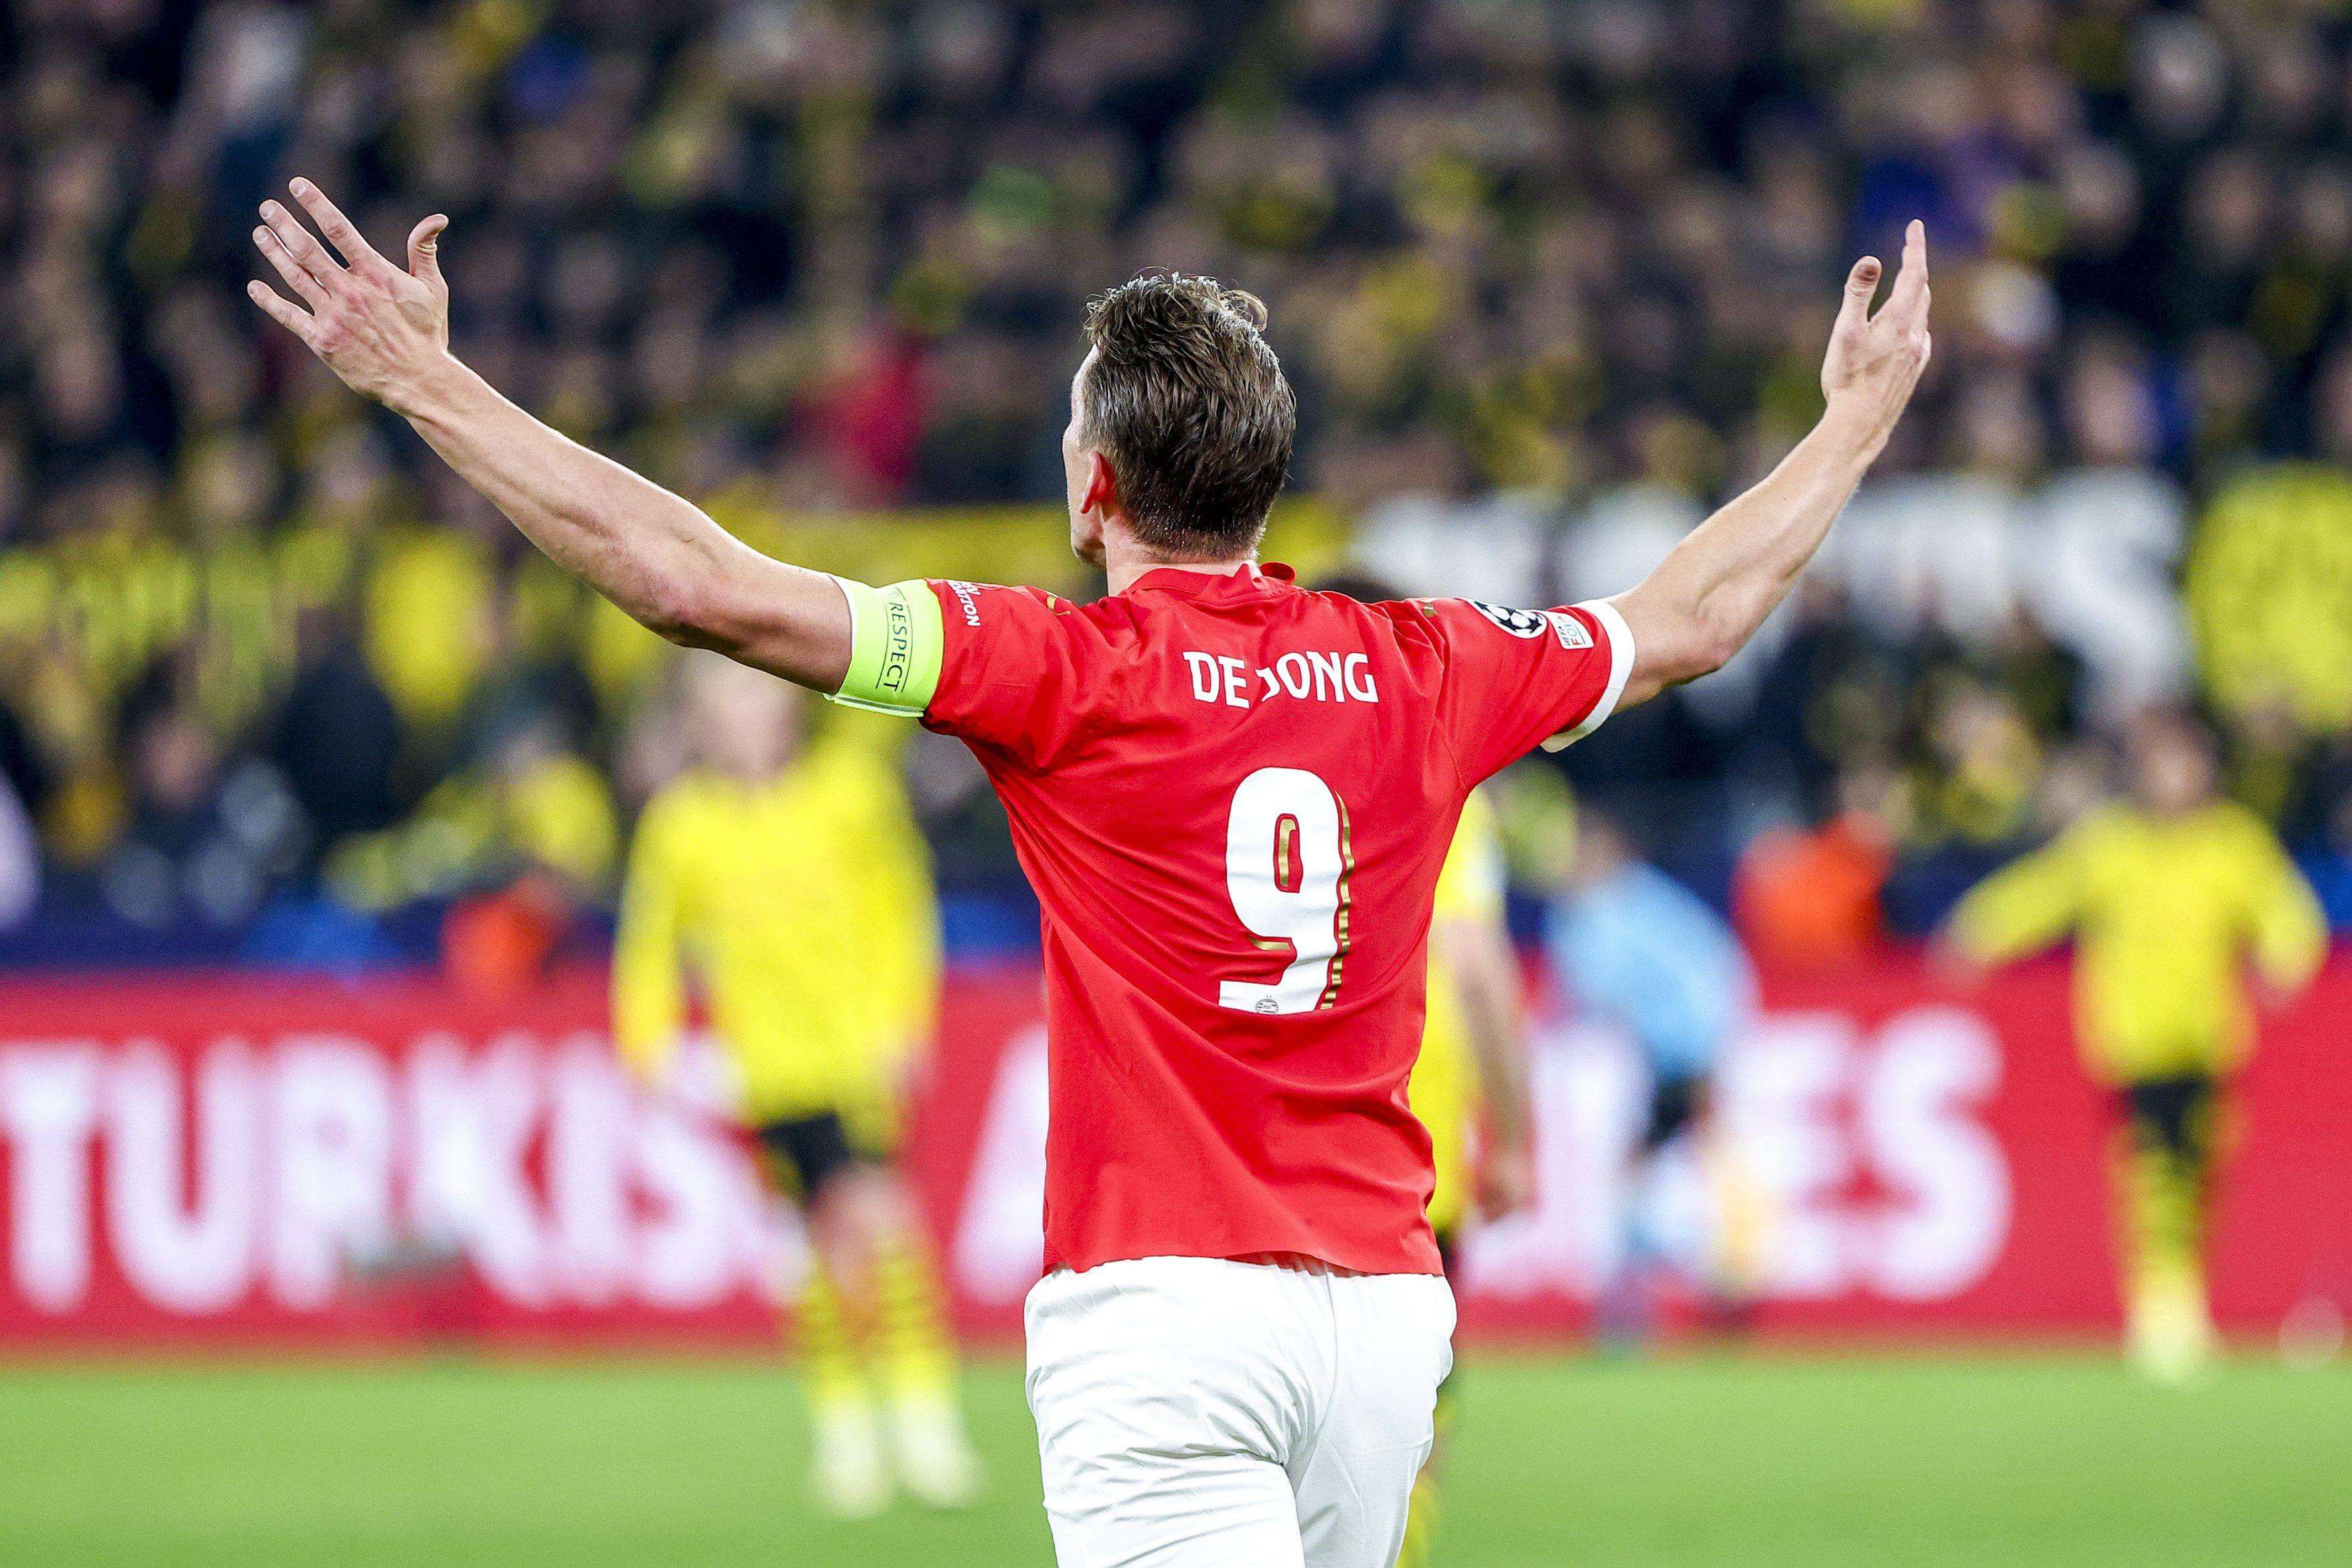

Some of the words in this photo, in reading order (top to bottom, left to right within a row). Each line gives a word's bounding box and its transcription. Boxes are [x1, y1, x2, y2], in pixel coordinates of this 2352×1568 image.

[884, 601, 907, 692] RESPECT
[1182, 651, 1250, 709] DE
[1255, 651, 1379, 703] JONG
[1218, 767, 1345, 1015] 9
[0, 1032, 820, 1309] TURKIS
